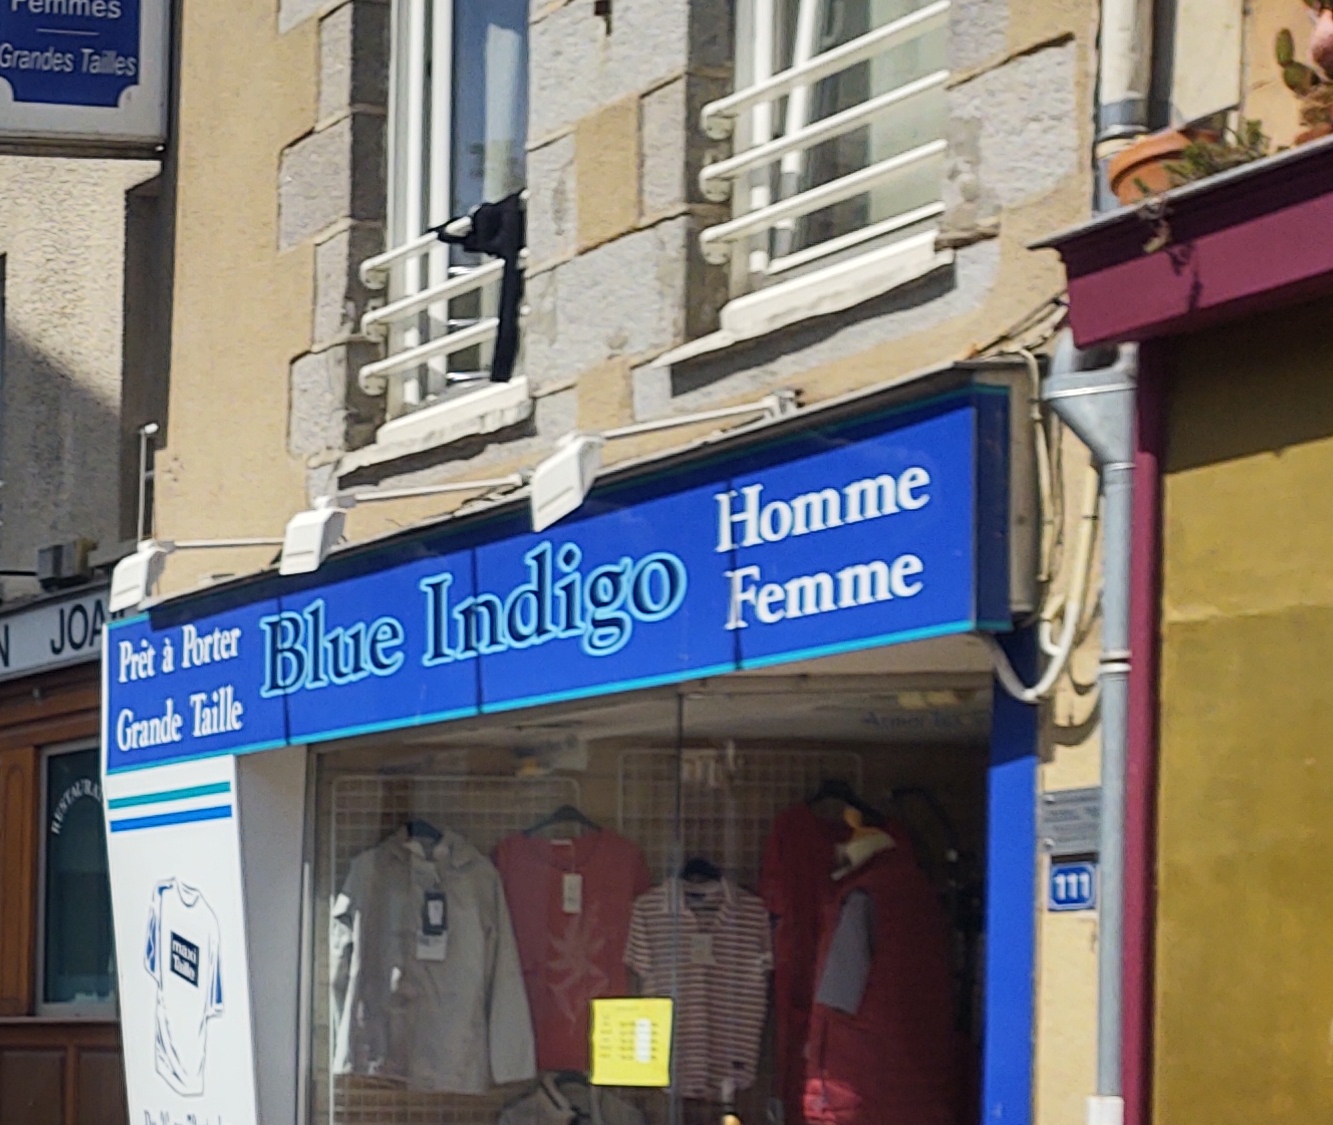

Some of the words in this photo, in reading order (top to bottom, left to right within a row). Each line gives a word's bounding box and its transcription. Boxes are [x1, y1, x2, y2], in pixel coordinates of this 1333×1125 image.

[81, 48, 136, 76] Tailles
[714, 466, 931, 553] Homme
[259, 598, 405, 698] Blue
[419, 540, 688, 667] Indigo
[723, 554, 923, 630] Femme
[51, 599, 125, 655] JOA
[118, 638, 156, 684] Prêt
[162, 637, 175, 673] à
[181, 623, 242, 669] Porter
[117, 697, 183, 752] Grande
[189, 683, 244, 738] Taille
[1054, 872, 1091, 900] 111
